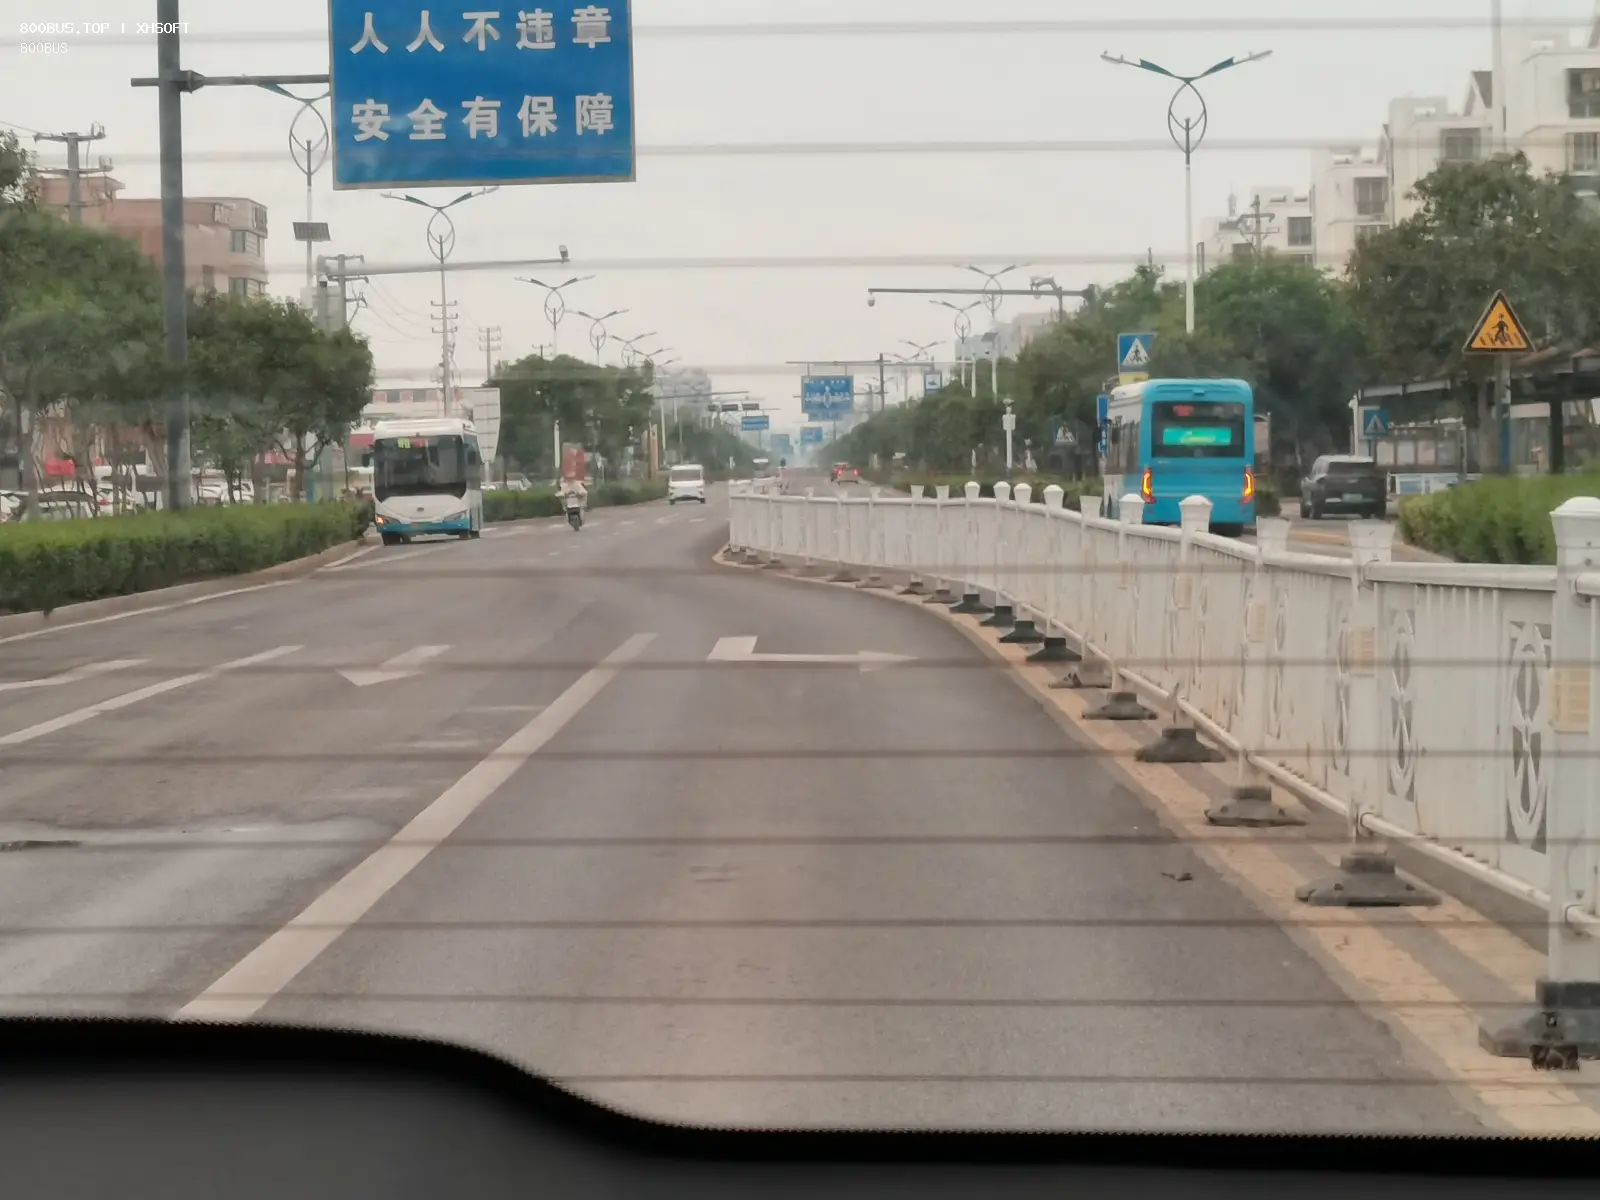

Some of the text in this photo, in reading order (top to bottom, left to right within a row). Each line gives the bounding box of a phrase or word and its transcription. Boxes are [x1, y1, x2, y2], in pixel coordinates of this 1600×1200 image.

[350, 5, 612, 54] 人人不违章
[351, 93, 614, 142] 安全有保障
